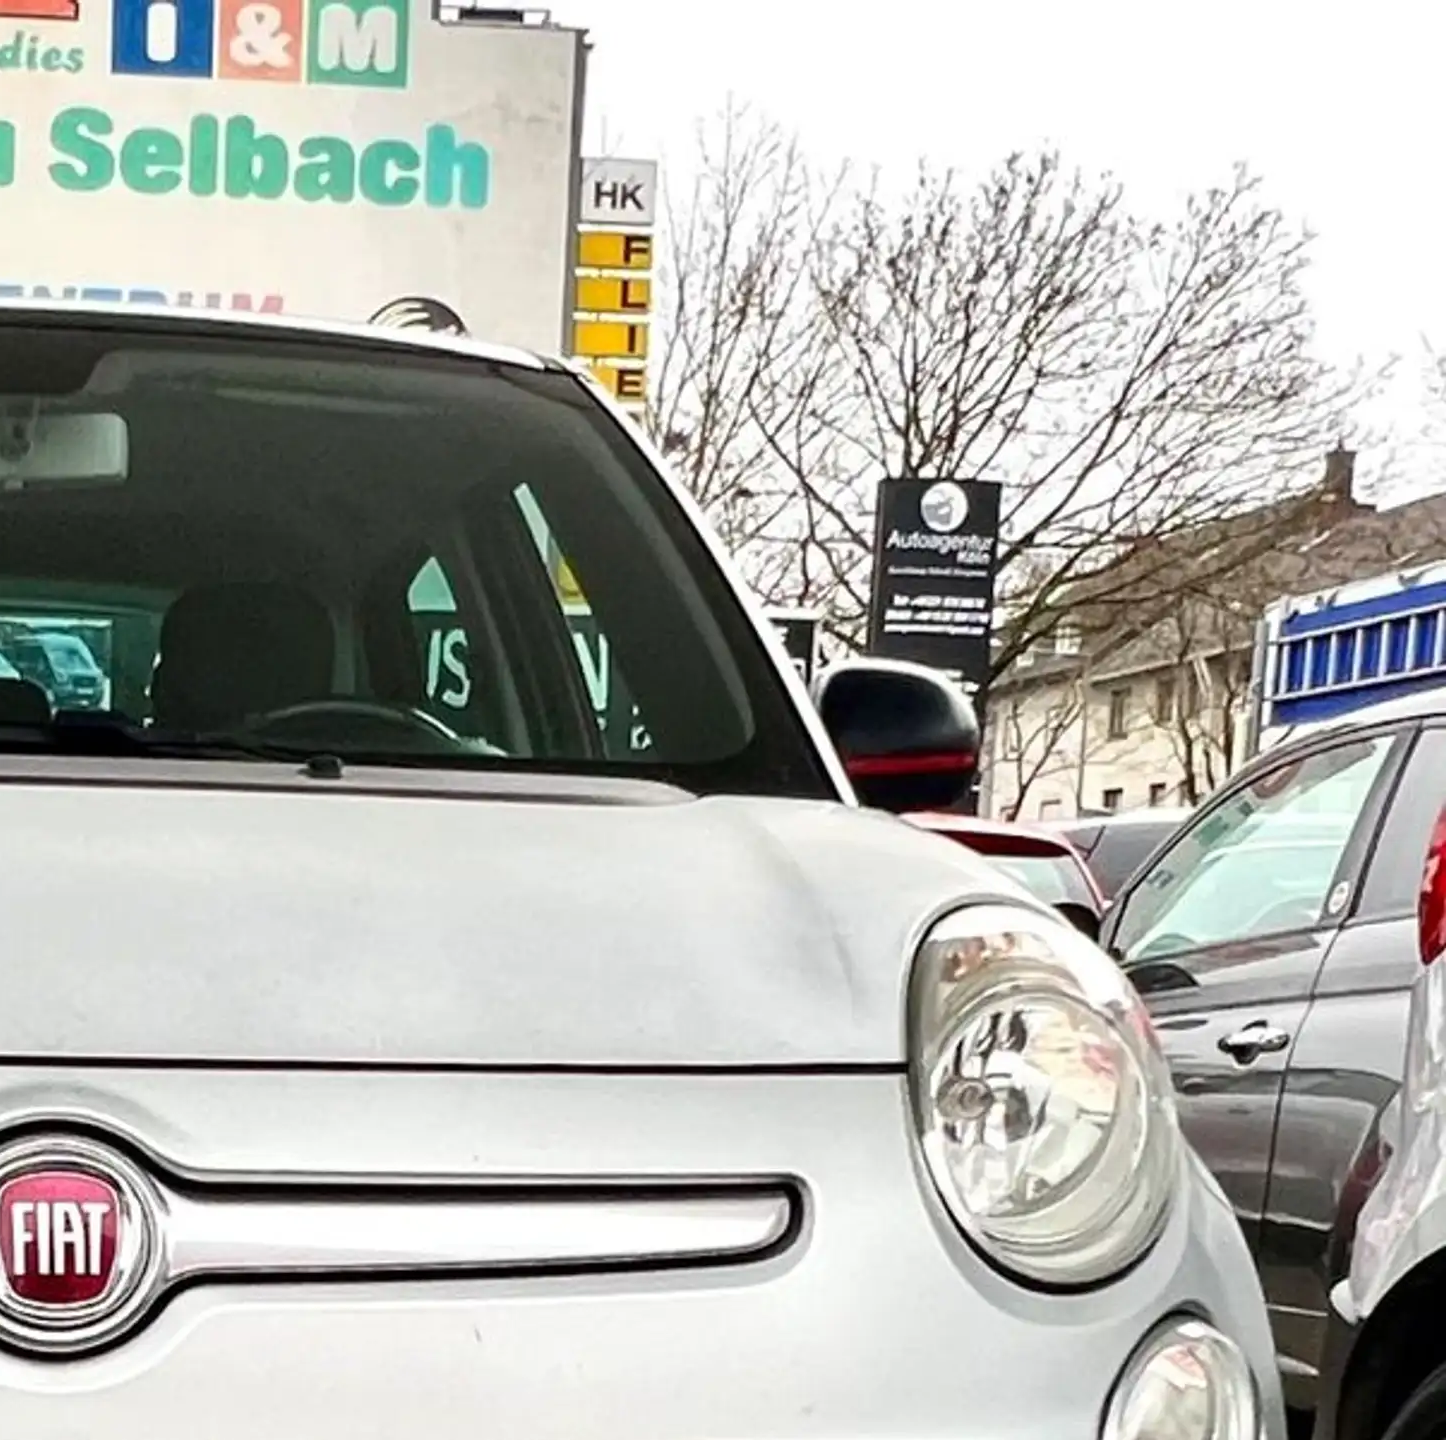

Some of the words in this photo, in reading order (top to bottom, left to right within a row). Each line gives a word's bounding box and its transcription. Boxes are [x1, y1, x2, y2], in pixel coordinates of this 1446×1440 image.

[47, 106, 490, 210] Selbach
[594, 181, 645, 211] HK
[10, 1200, 111, 1276] FIAT
